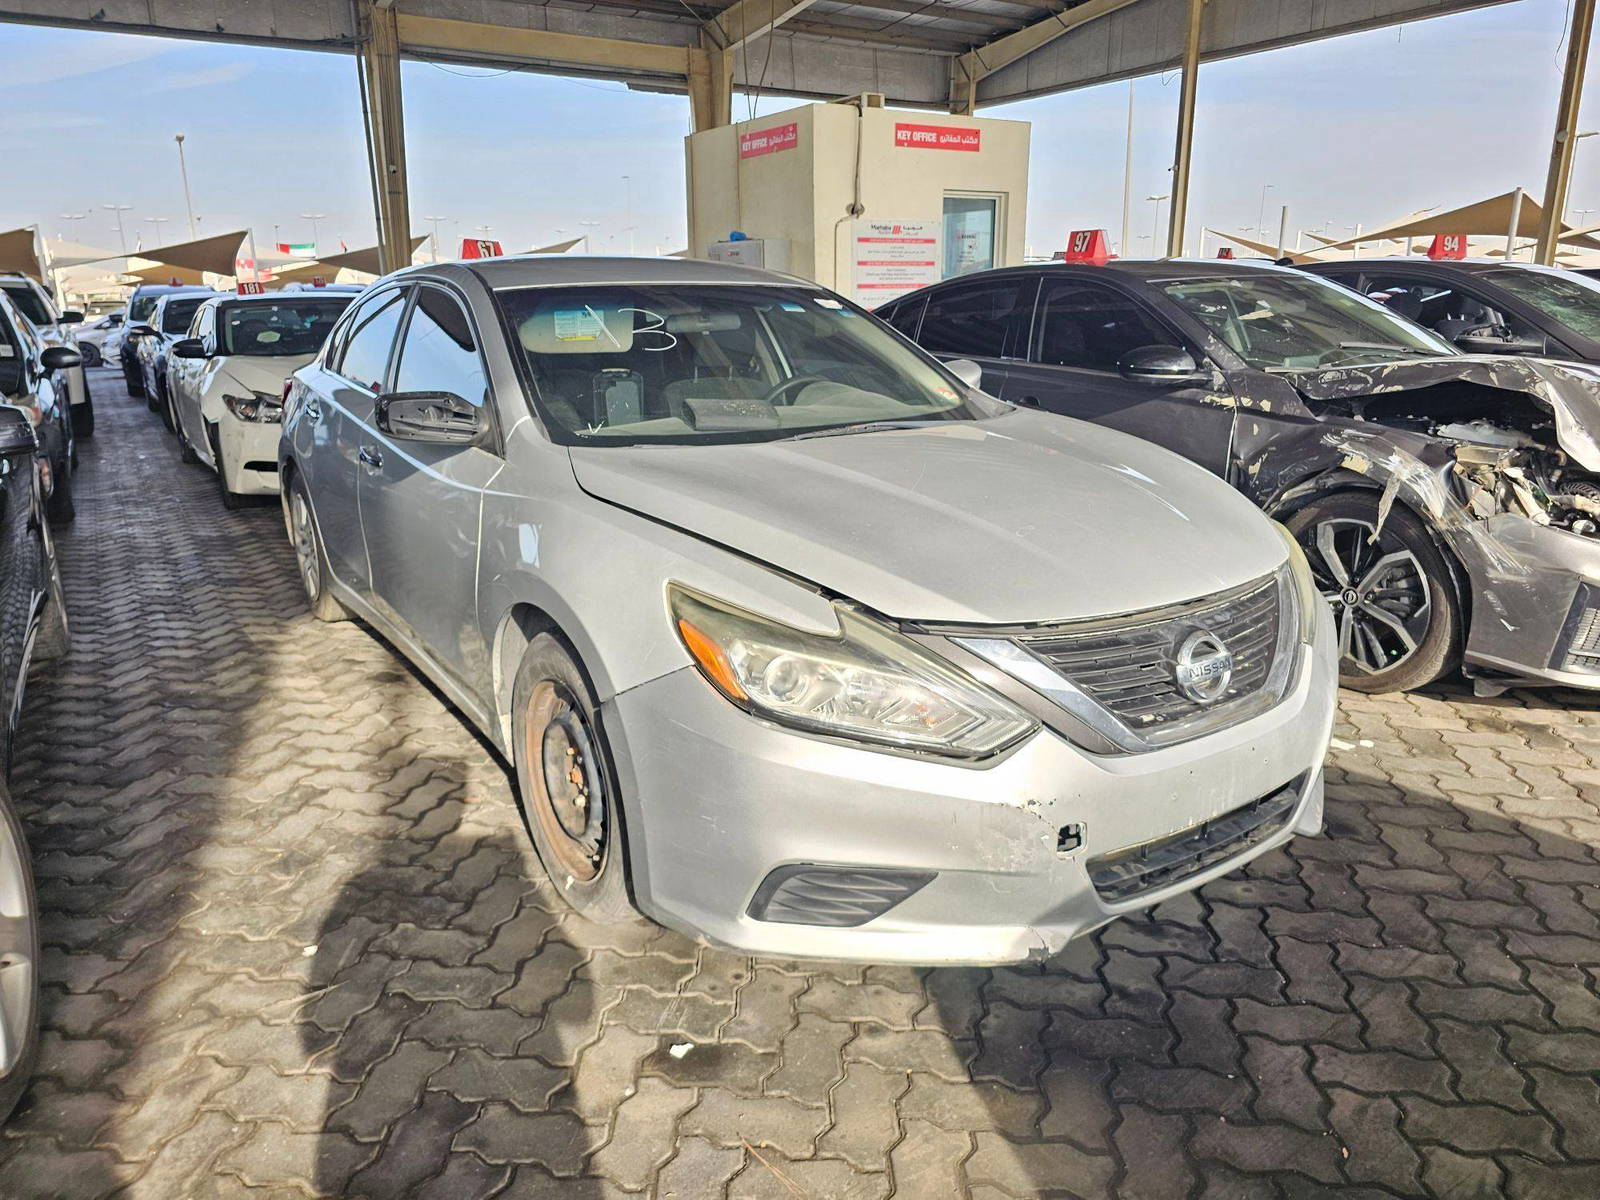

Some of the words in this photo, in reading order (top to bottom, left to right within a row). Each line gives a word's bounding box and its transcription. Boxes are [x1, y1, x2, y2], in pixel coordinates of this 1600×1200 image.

[897, 130, 911, 141] KEY
[912, 131, 938, 143] OFFICE
[477, 240, 495, 258] 67
[1074, 231, 1091, 252] 97
[1443, 235, 1459, 252] 94
[243, 282, 260, 295] 181
[1188, 656, 1231, 678] NISSAN
